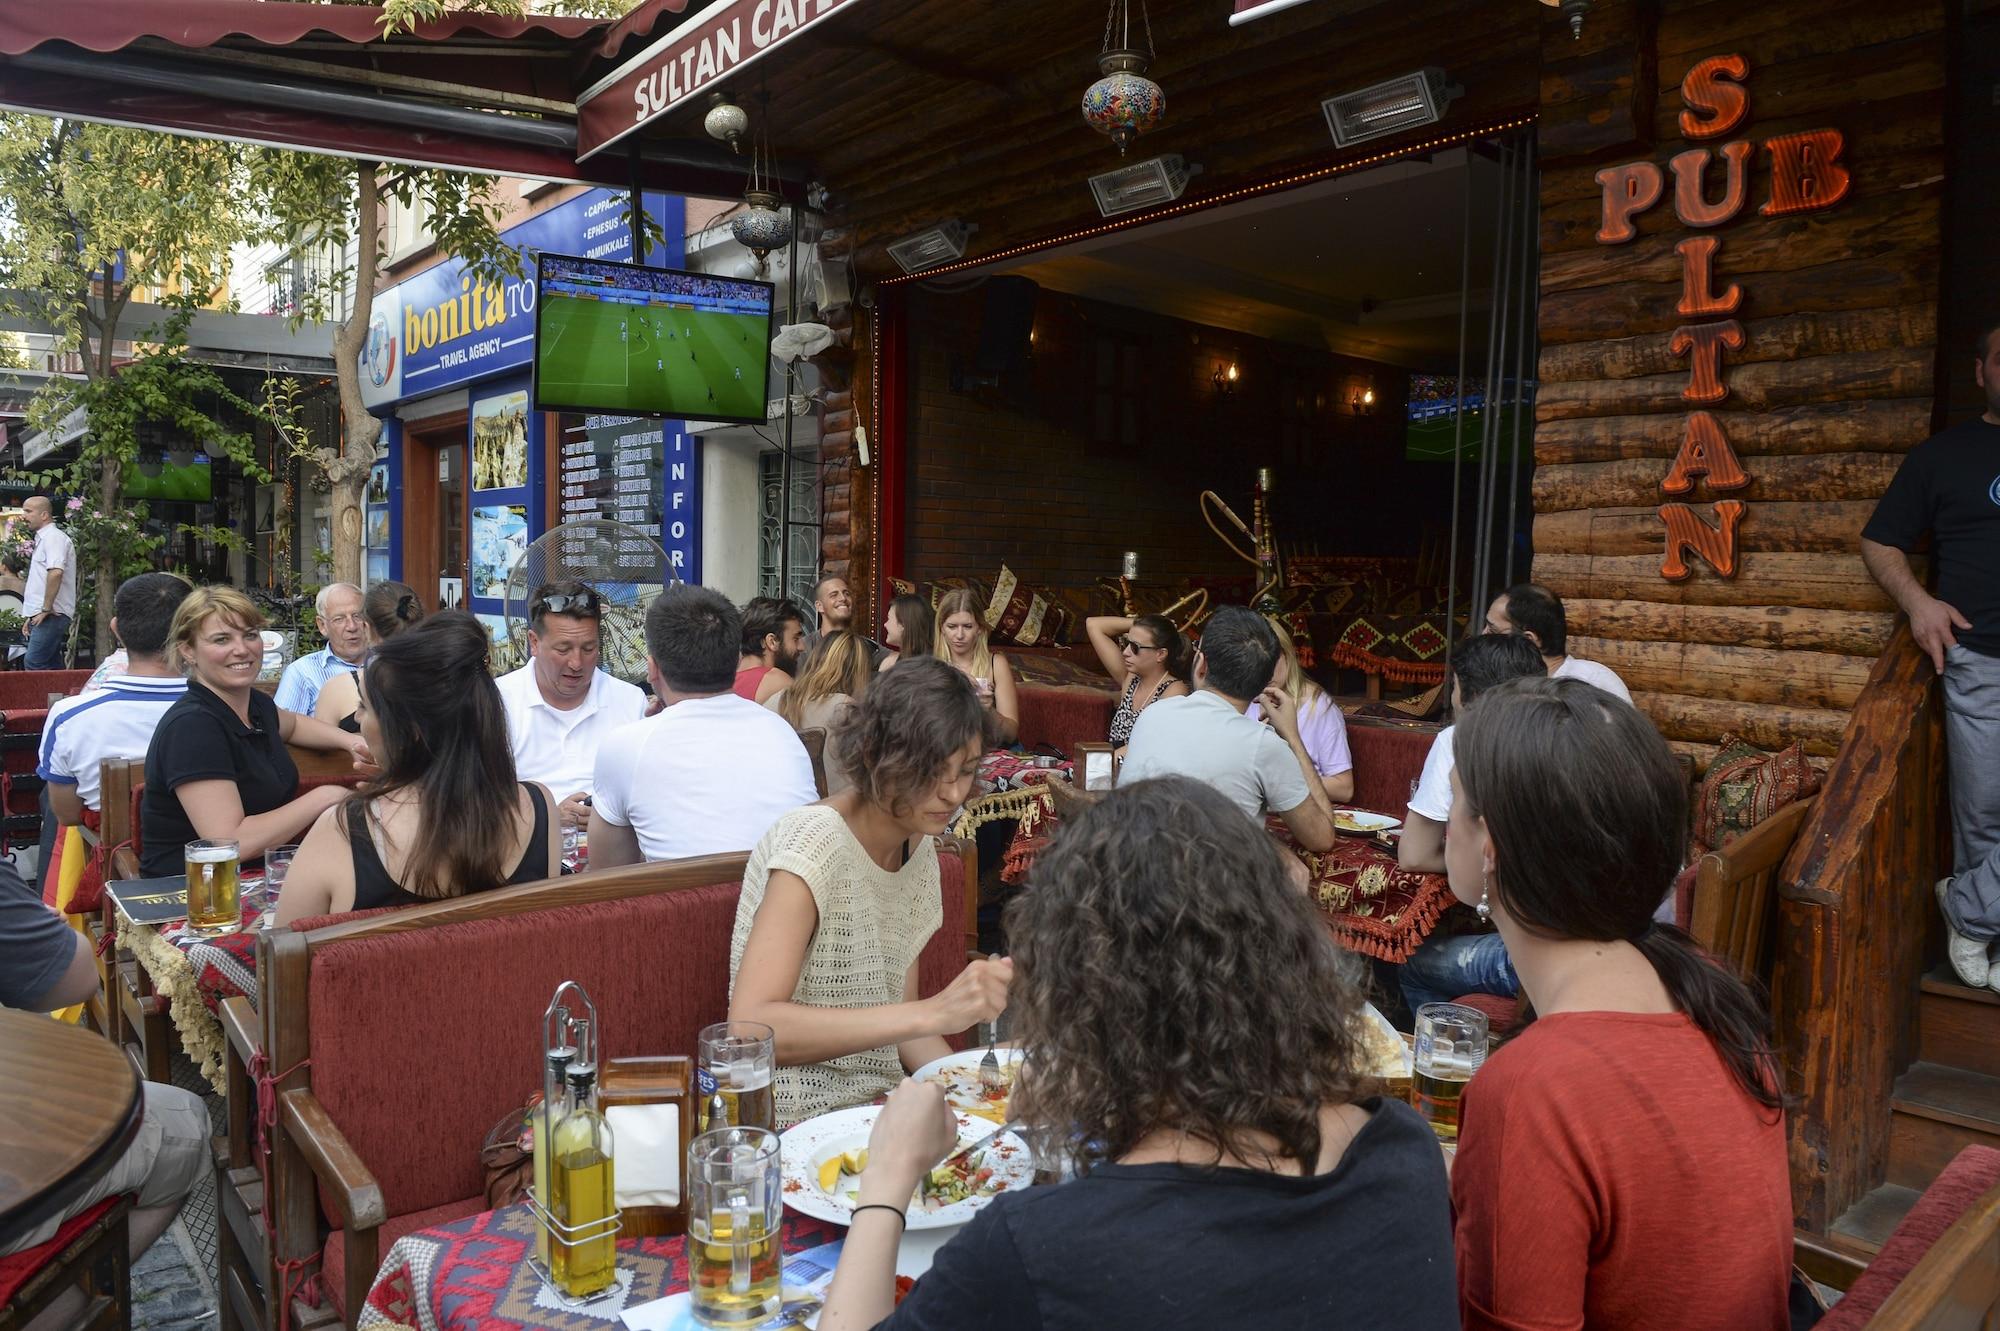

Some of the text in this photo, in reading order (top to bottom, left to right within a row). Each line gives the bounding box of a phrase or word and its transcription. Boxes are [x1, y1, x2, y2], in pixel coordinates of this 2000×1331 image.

[634, 17, 740, 122] SULTAN
[587, 216, 619, 240] EPHESUS
[1594, 127, 1851, 245] PUB
[586, 234, 629, 260] PAMUKKALE
[404, 272, 507, 356] bonita
[440, 337, 501, 369] TRAVEL AGENCY
[1658, 52, 1753, 581] SULTAN
